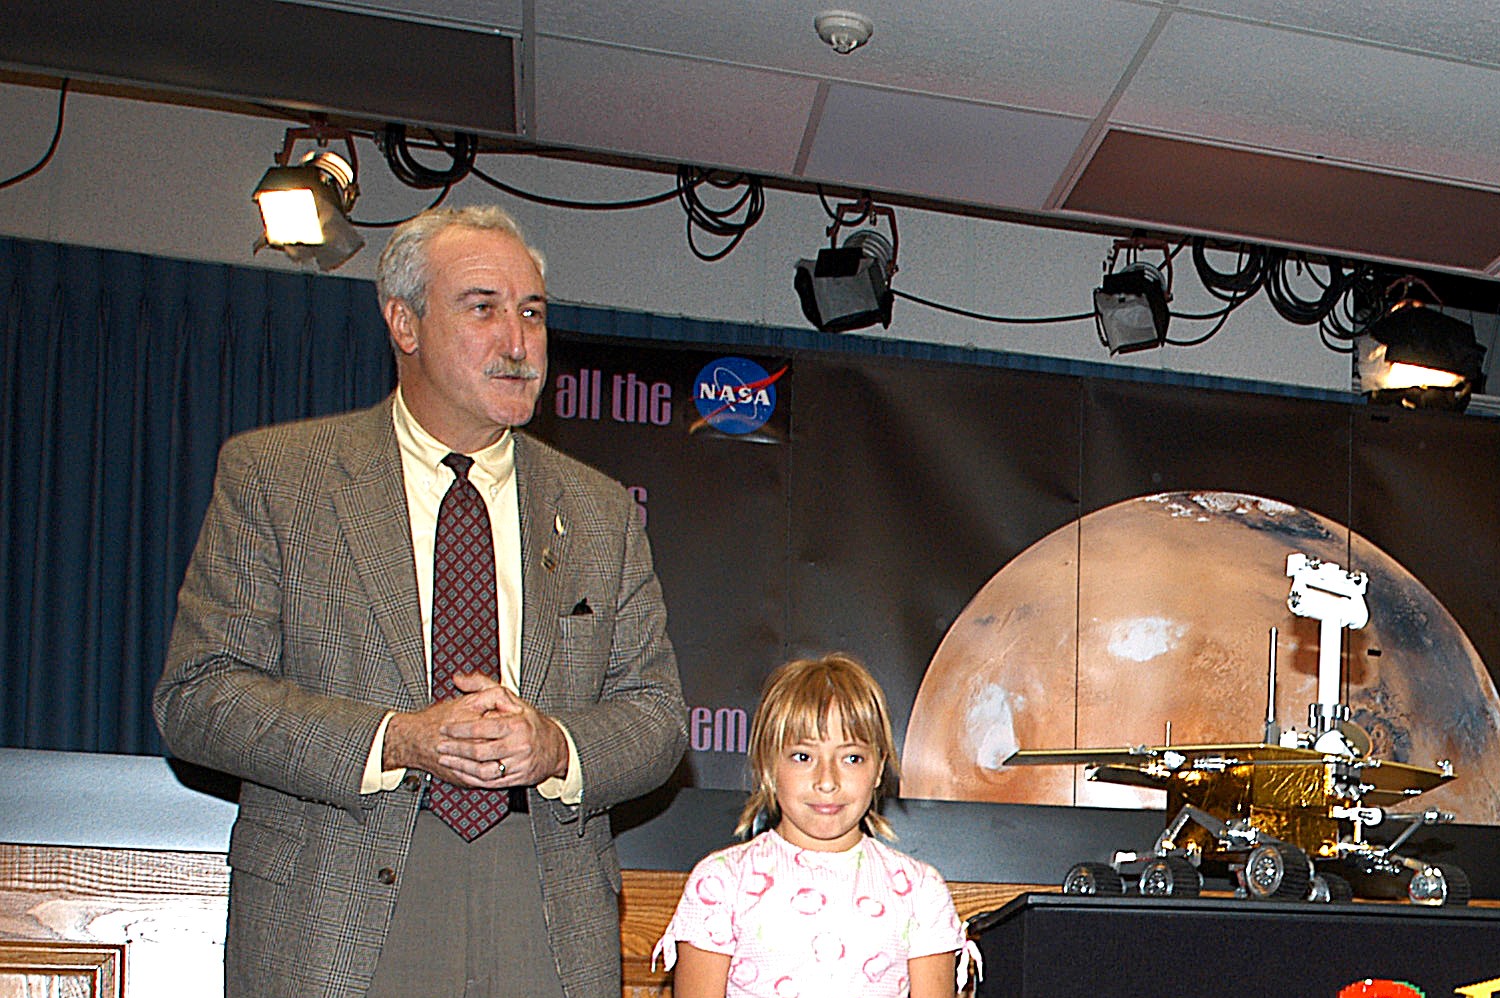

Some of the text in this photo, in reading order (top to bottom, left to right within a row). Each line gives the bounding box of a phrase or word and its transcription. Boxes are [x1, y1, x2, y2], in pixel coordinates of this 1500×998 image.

[555, 369, 672, 426] all the
[700, 383, 771, 406] NASA
